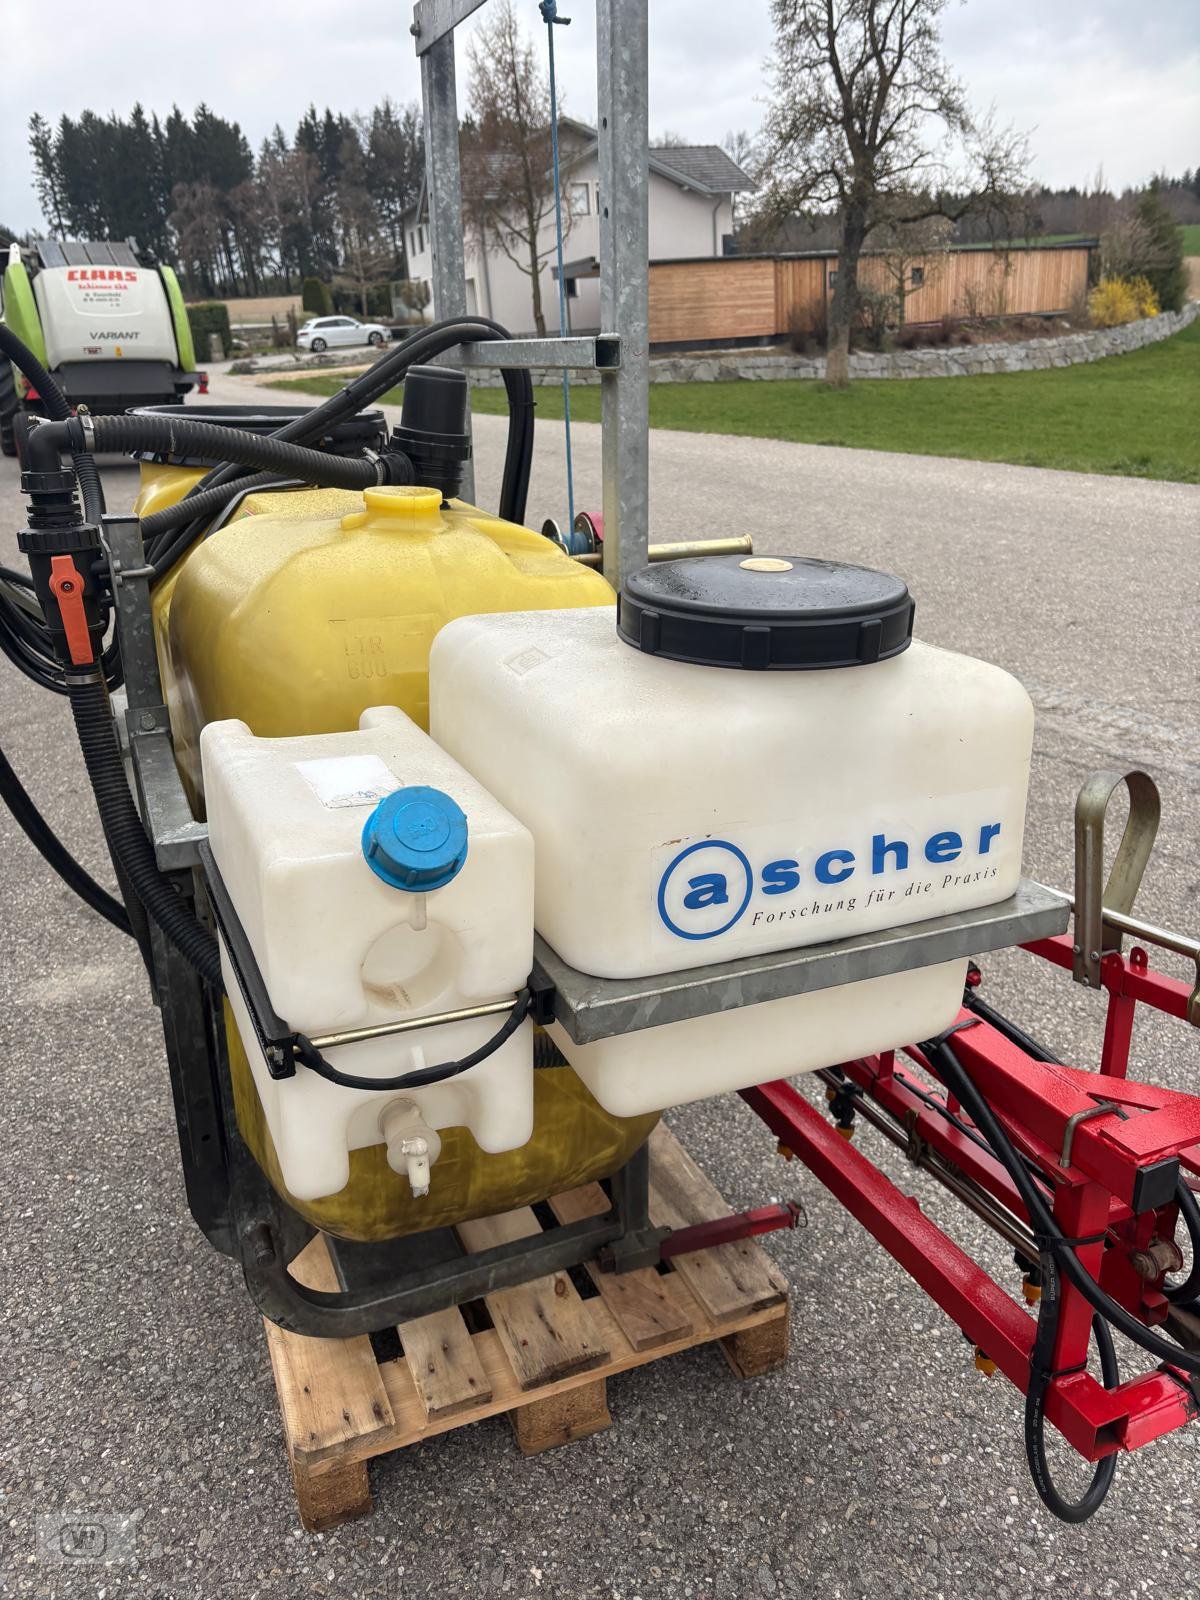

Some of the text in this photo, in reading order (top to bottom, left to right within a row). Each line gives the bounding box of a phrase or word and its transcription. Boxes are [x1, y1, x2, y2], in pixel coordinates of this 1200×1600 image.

[68, 270, 137, 281] CLAAS
[752, 866, 997, 926] Forschung für die Praxis
